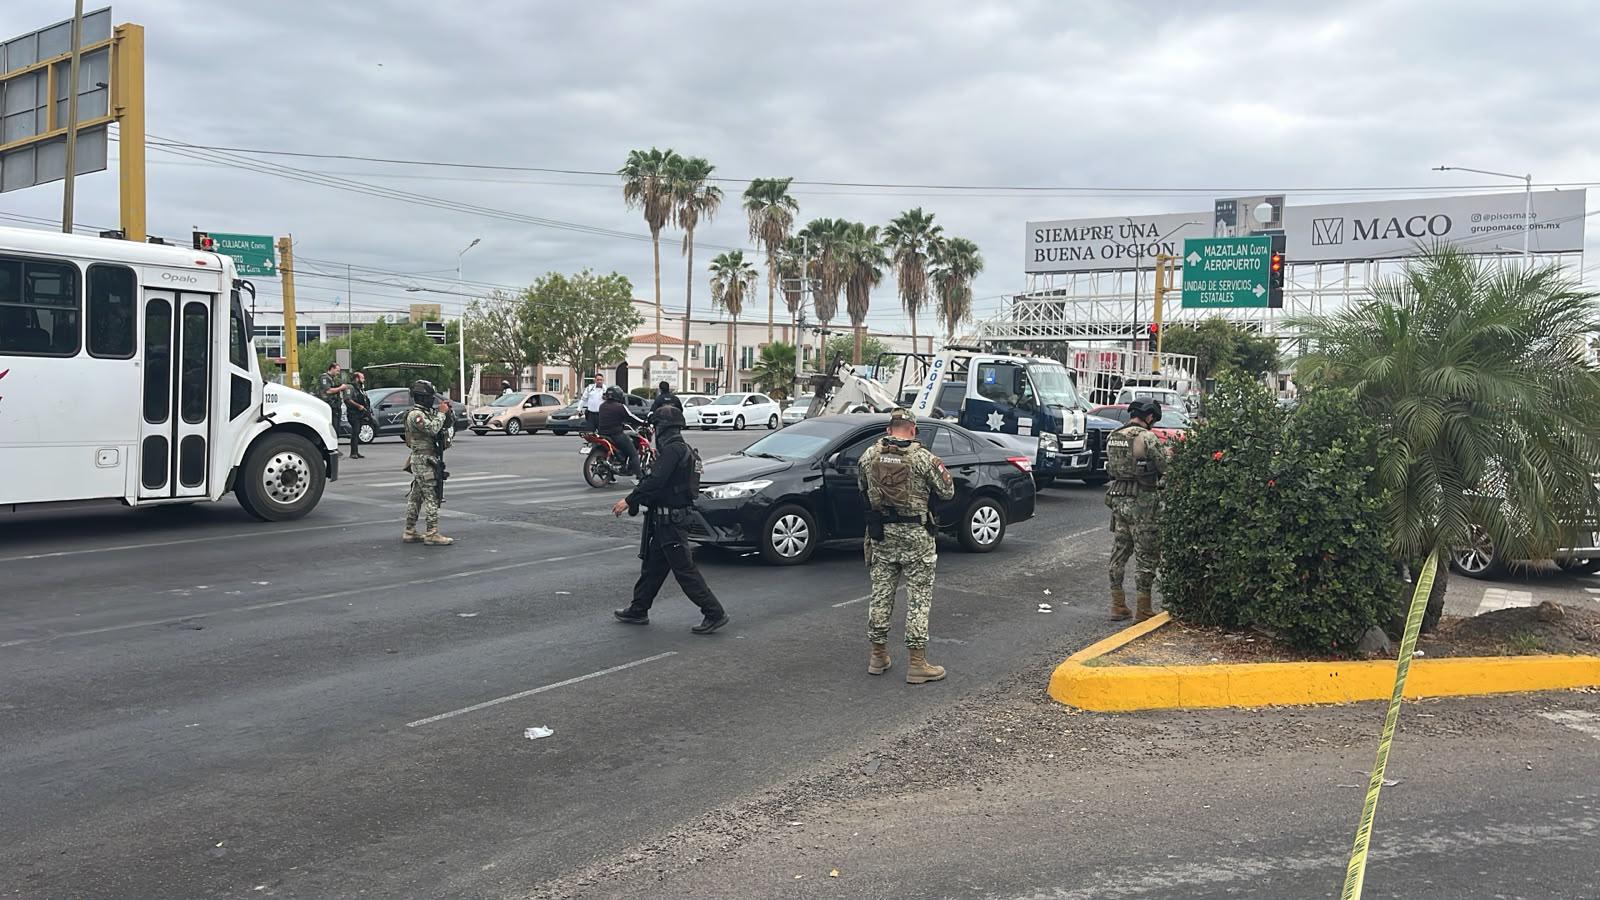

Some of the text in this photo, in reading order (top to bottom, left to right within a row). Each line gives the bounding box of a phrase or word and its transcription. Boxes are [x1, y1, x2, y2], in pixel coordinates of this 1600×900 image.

[1034, 222, 1160, 243] SIEMPRE UNA
[1352, 214, 1452, 241] MACO
[1471, 222, 1560, 234] grupomaco.om.mx
[1034, 246, 1096, 263] BUENA
[1204, 244, 1248, 257] MAZATLAN
[1203, 258, 1261, 271] AEROPUERTO
[161, 272, 198, 284] Opalo
[1184, 279, 1252, 292] UNIDAD DE SERVICIOS
[1200, 292, 1235, 303] ESTATALES
[265, 393, 279, 404] 1200
